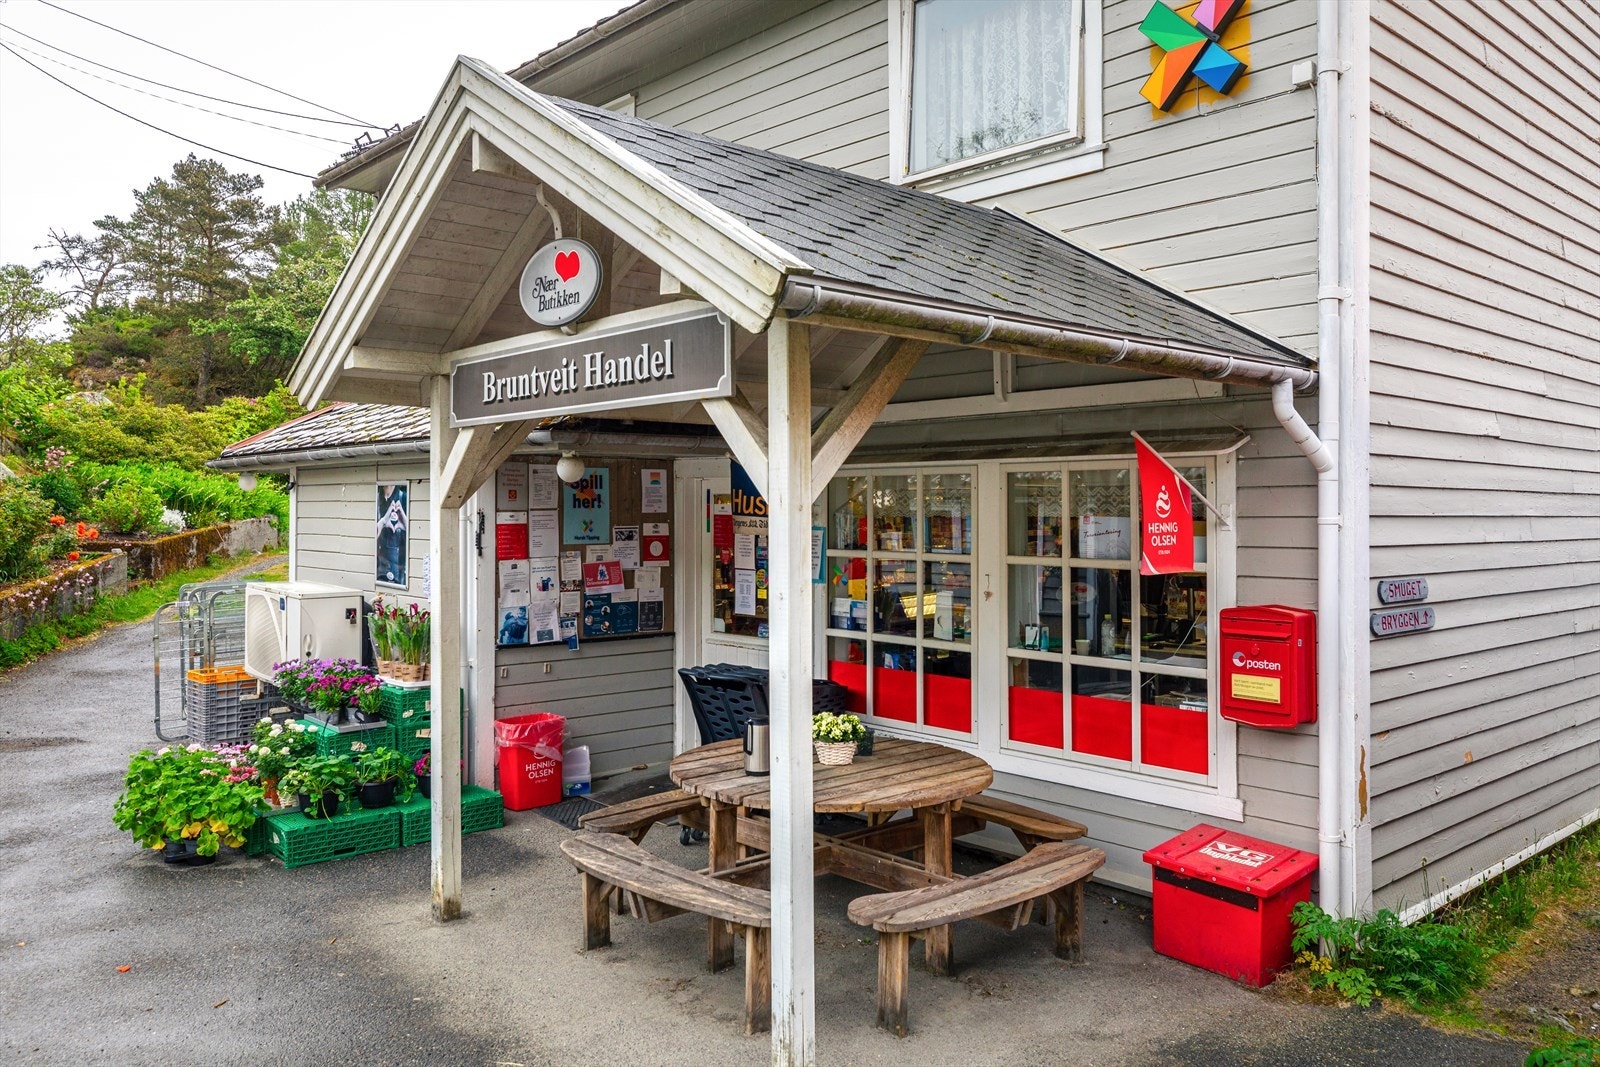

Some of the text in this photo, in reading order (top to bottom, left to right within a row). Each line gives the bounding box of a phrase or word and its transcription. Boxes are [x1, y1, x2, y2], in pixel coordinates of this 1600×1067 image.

[532, 276, 559, 298] Nær
[538, 289, 580, 312] Butikken
[482, 339, 673, 403] Bruntveit Handel
[572, 494, 602, 509] her!
[732, 489, 768, 515] Hus
[1148, 522, 1178, 533] HENNIG
[1151, 535, 1177, 547] OLSEN
[1388, 580, 1421, 598] SMUGET
[1381, 611, 1420, 631] BRYGGEN
[1246, 659, 1281, 671] posten
[525, 760, 556, 772] HENNIG
[528, 768, 554, 779] OLSEN
[1215, 842, 1268, 861] VG
